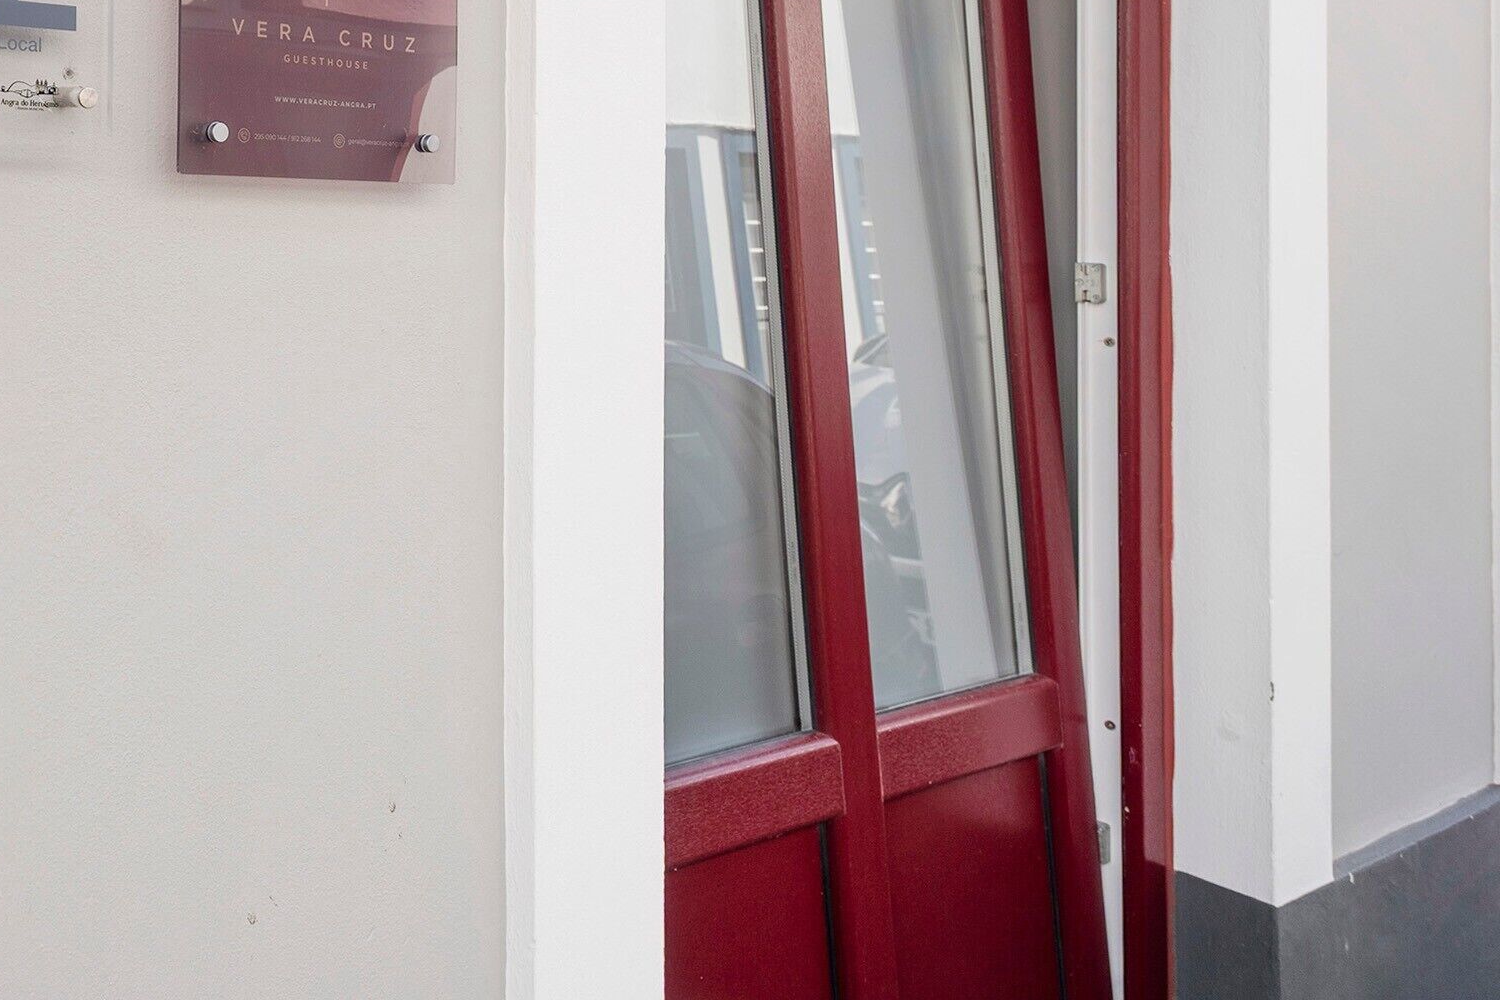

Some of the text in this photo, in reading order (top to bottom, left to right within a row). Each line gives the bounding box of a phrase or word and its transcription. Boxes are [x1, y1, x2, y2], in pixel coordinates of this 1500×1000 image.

[232, 18, 415, 53] VERA CRUZ
[283, 54, 368, 70] GUESTHOUSE
